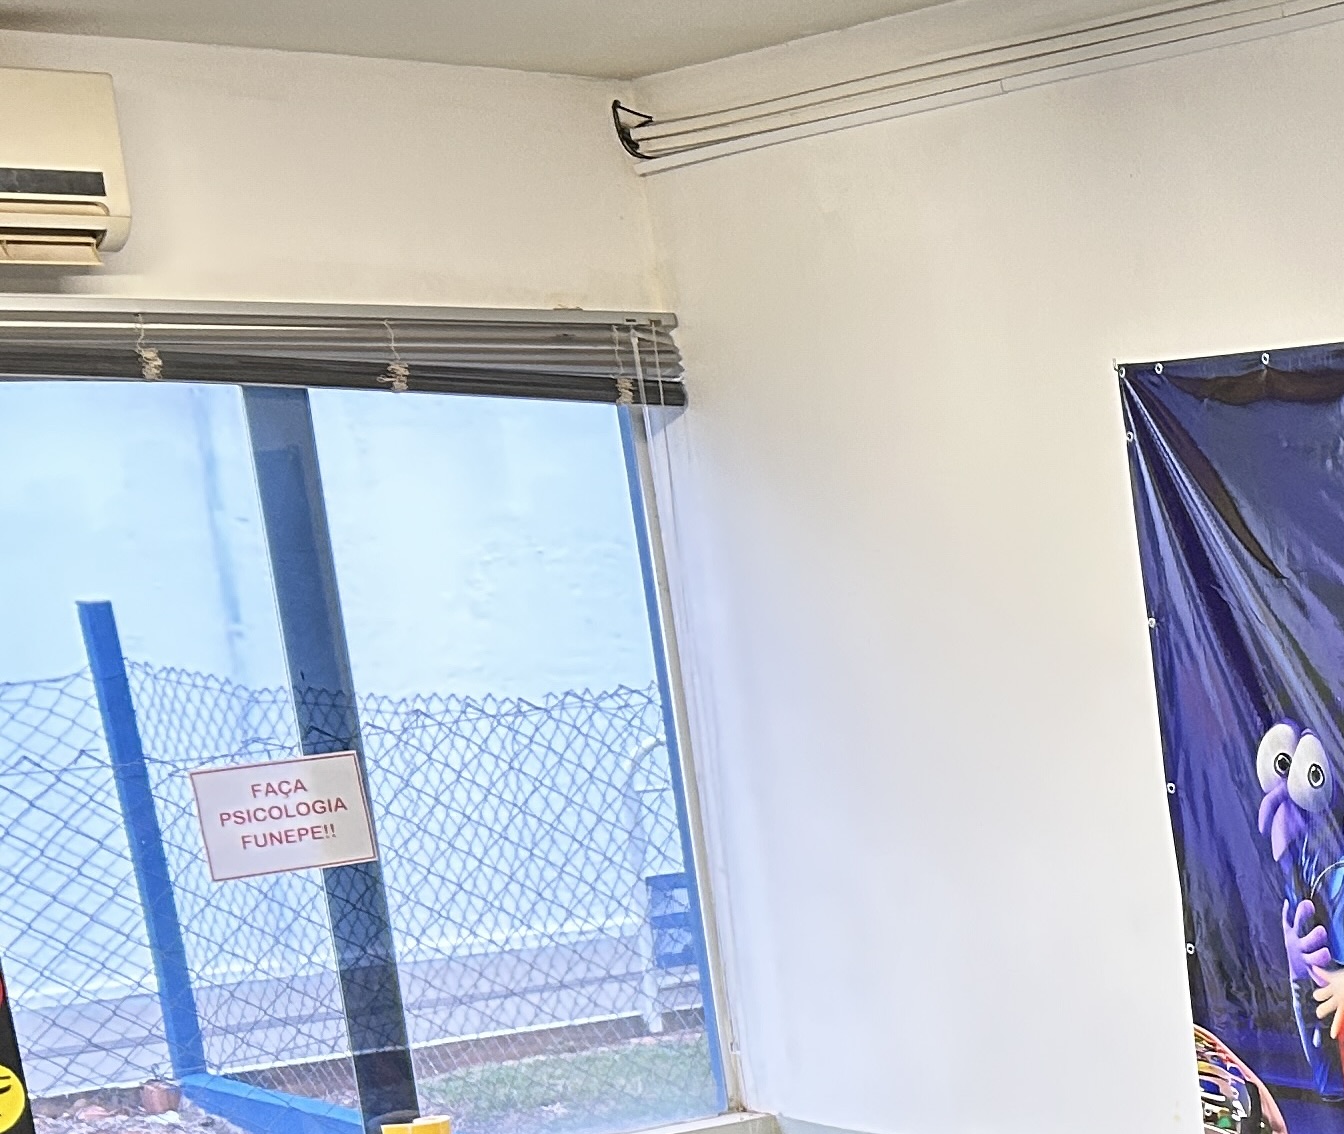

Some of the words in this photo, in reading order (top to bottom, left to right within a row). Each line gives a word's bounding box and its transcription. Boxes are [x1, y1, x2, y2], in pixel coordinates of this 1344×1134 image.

[250, 778, 308, 799] FAÇA
[219, 796, 349, 827] PSICOLOGIA
[240, 823, 338, 850] FUNEPE!!
